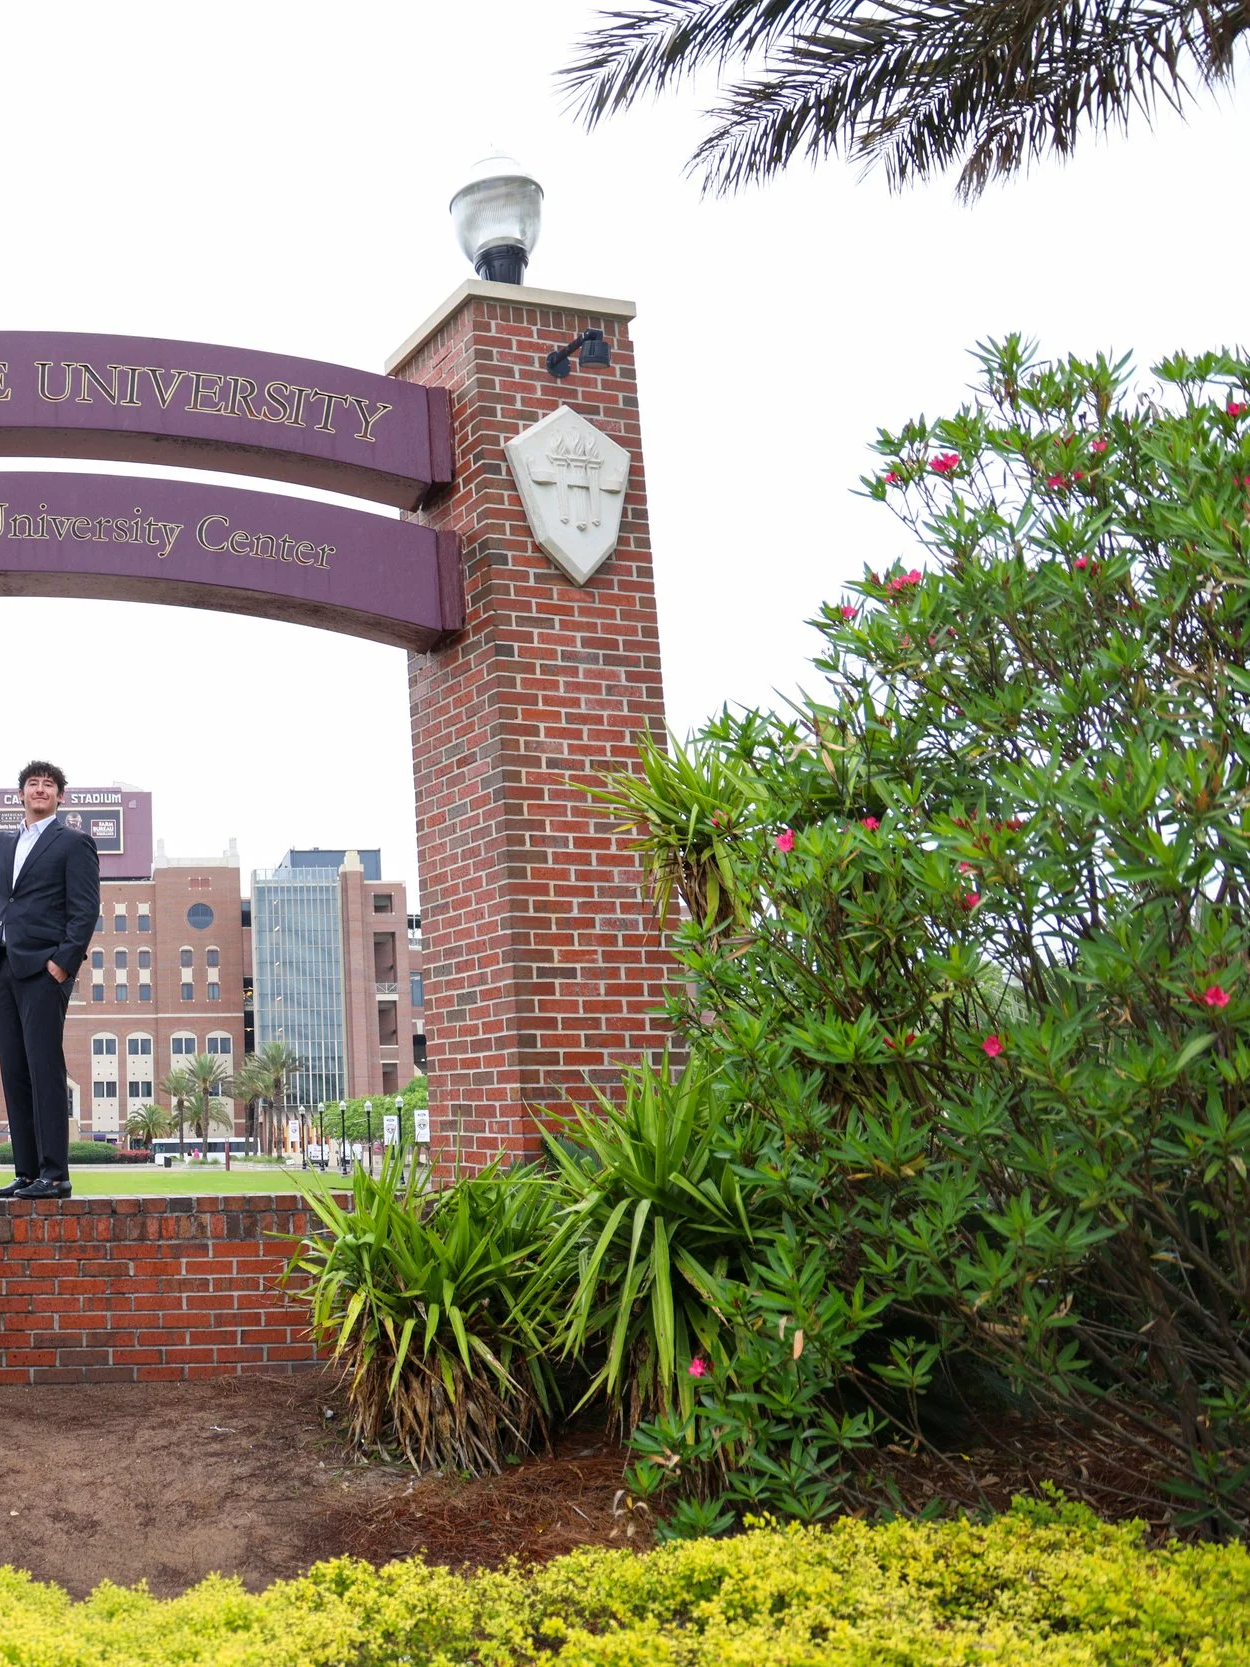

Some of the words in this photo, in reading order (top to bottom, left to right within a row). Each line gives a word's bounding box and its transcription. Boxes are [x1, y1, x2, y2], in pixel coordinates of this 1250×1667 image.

[35, 361, 392, 442] UNIVERSITY
[196, 515, 336, 569] Center
[71, 793, 121, 804] STADIUM
